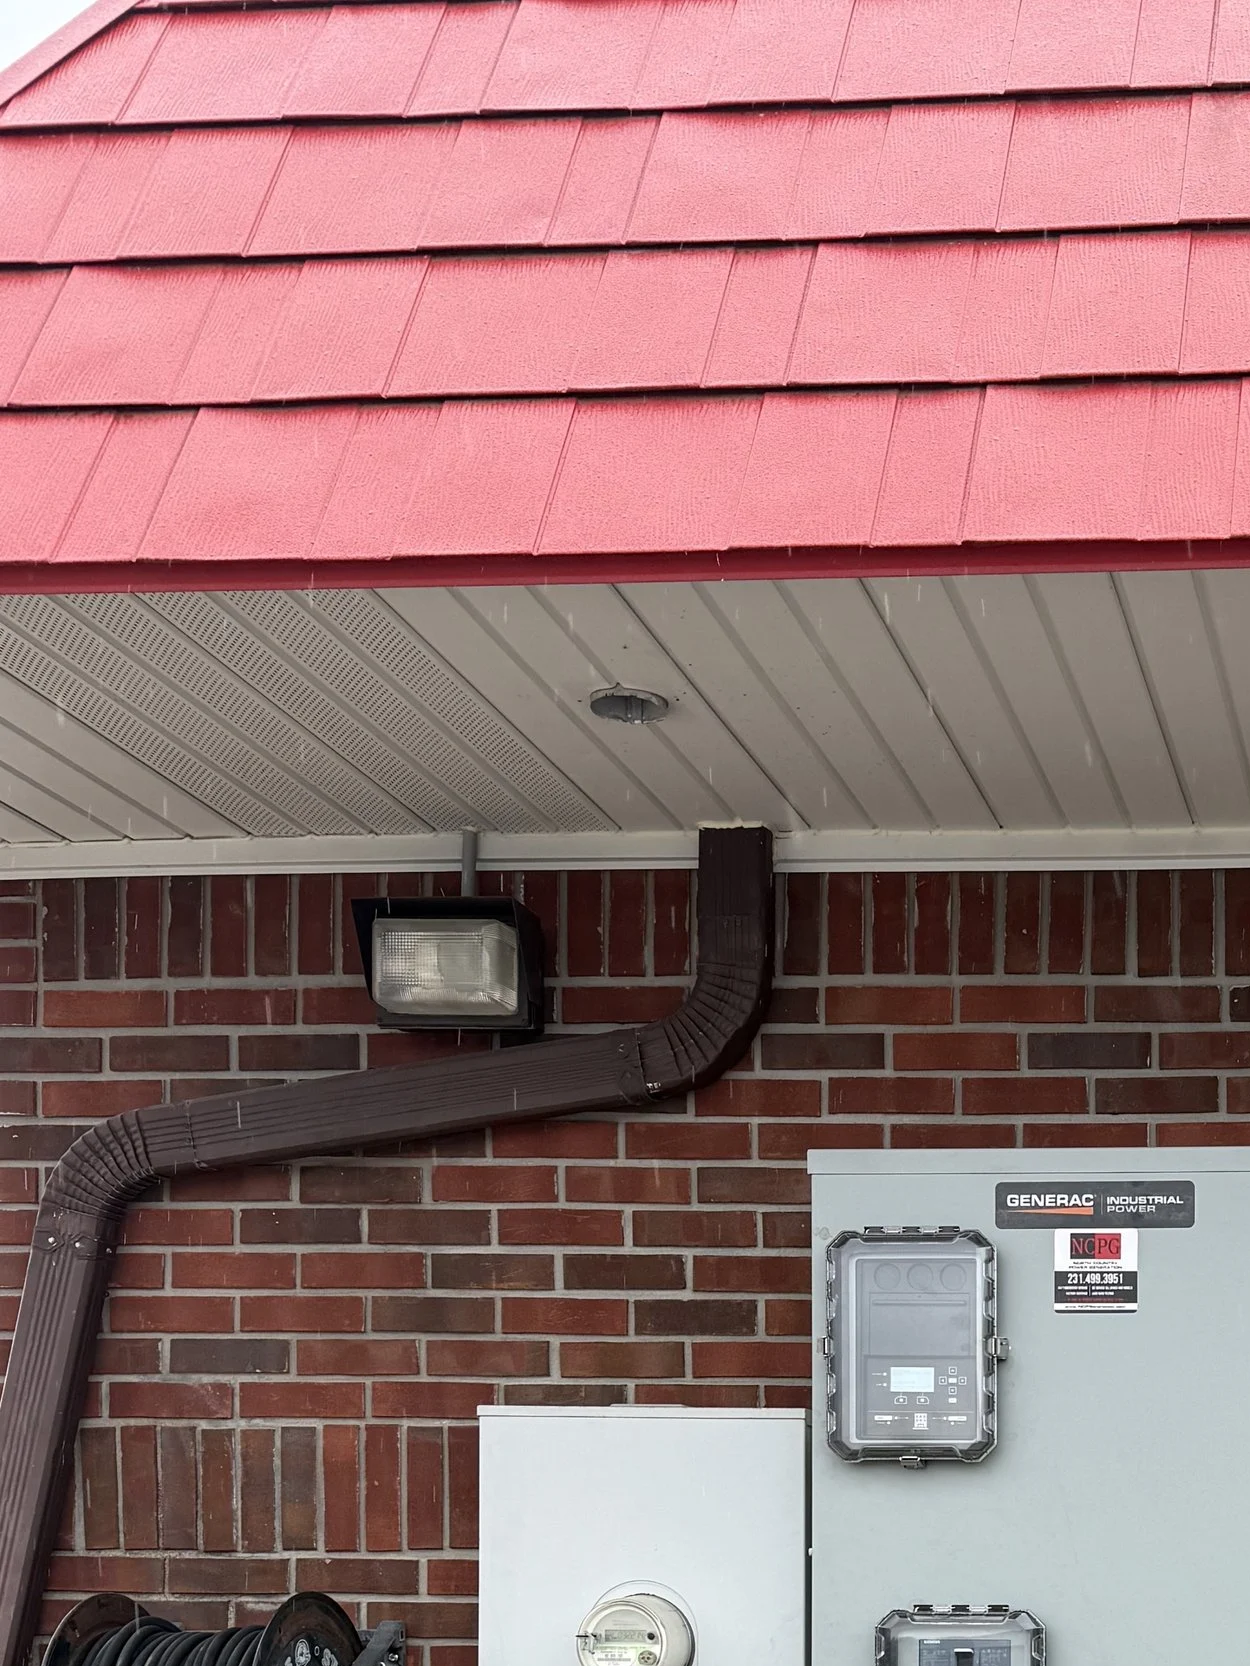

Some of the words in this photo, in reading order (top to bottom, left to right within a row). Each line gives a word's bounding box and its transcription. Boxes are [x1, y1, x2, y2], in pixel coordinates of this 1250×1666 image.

[1006, 1193, 1094, 1207] GENERAC
[1106, 1195, 1184, 1205] INDUSTRIAL
[1106, 1205, 1156, 1213] POWER
[1071, 1237, 1120, 1255] NCPG
[1067, 1273, 1123, 1284] 231.499.3951
